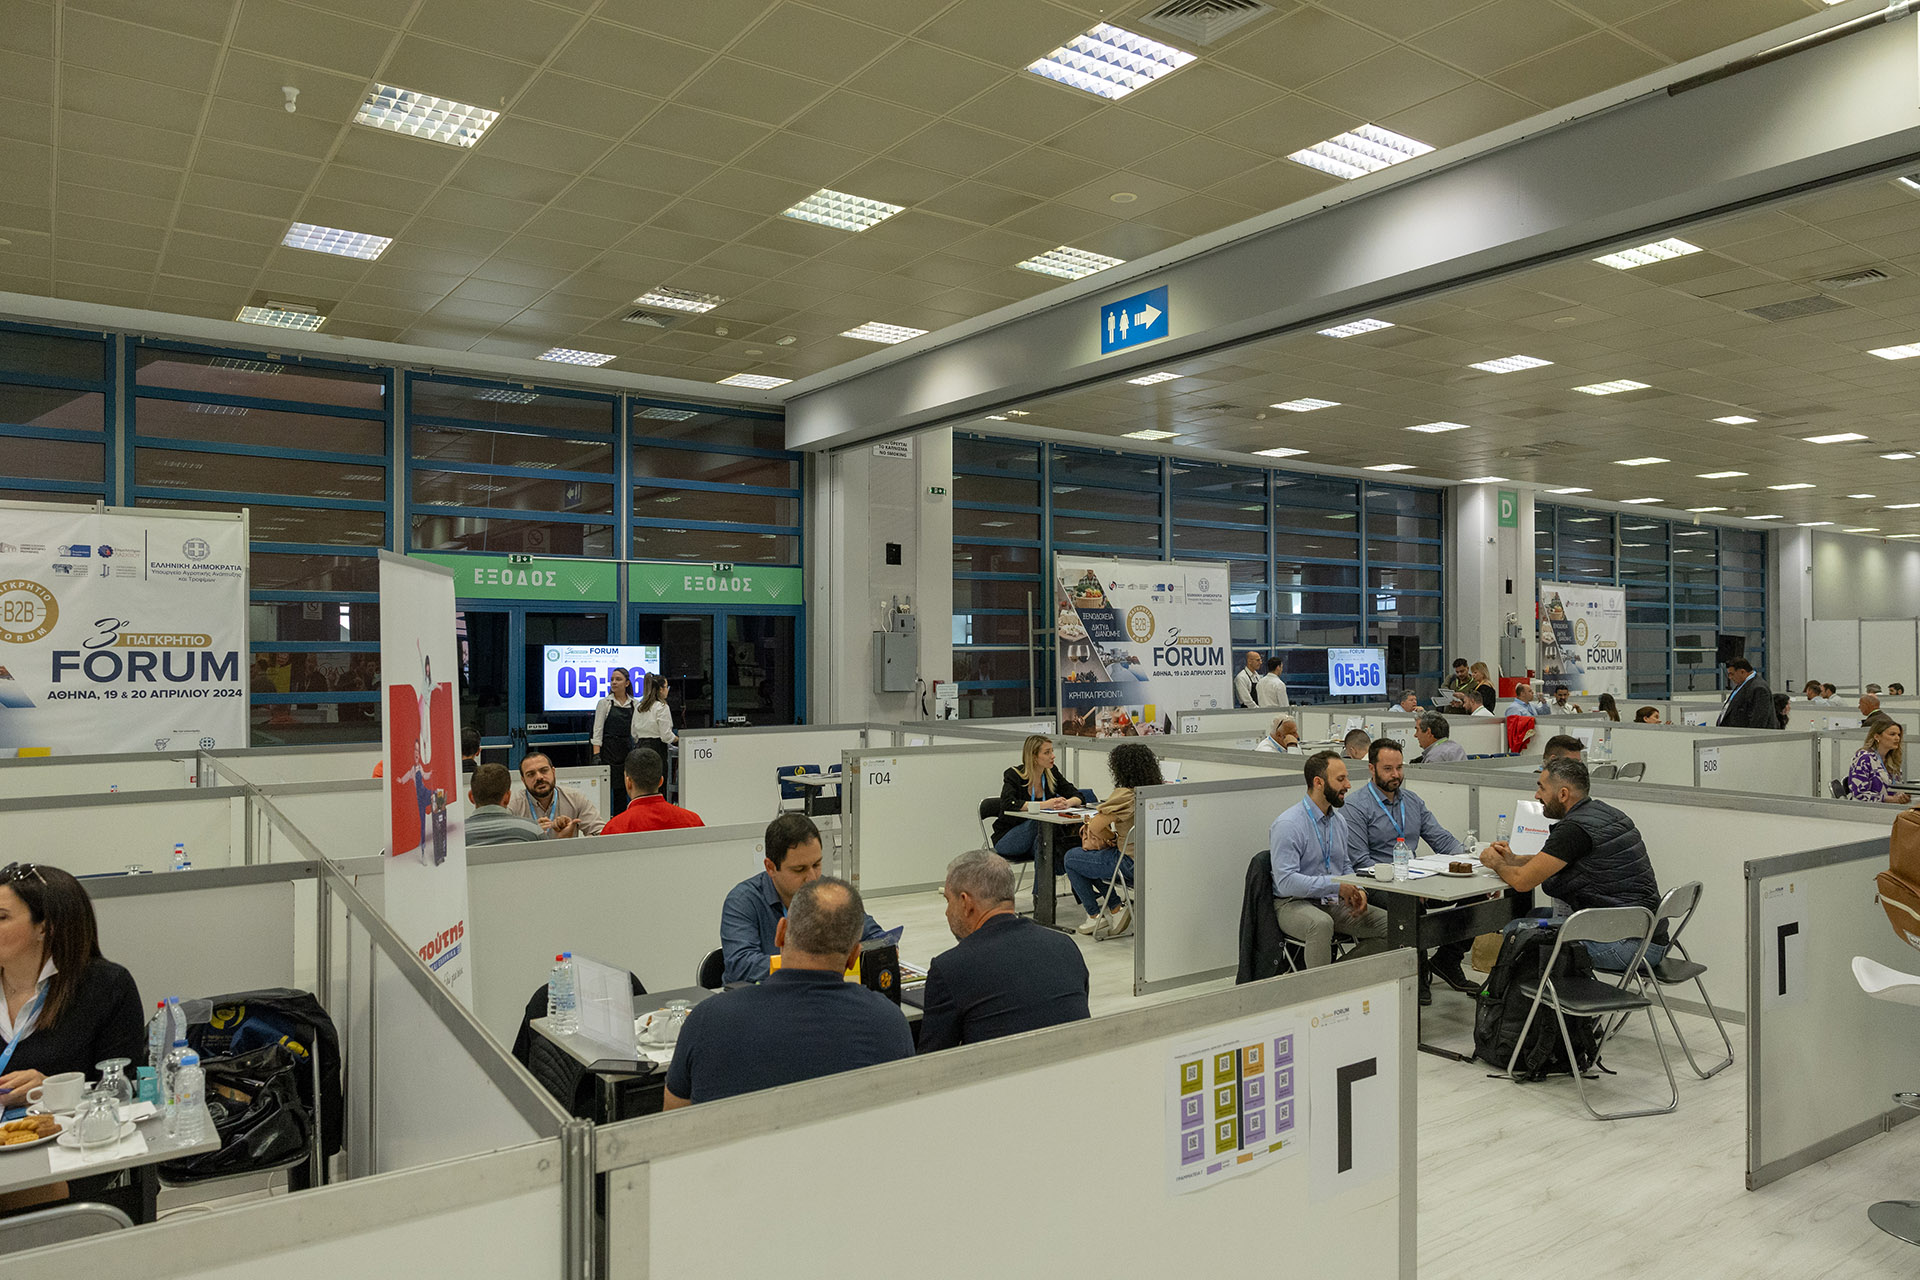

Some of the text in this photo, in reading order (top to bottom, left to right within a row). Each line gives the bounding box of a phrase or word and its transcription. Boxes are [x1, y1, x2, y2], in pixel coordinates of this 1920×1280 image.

[1502, 499, 1512, 518] D
[192, 563, 242, 571] ΔΗΜΟΚΡΑΤΙΑ
[474, 568, 556, 587] ΕΞΟΔΟΣ
[684, 576, 752, 592] ΕΞΟΔΟΣ
[0, 582, 51, 600] ΓΚΡΗΤΙΟ
[4, 601, 34, 622] B2B
[0, 628, 47, 642] ORUM
[126, 635, 205, 646] ΠΑΓΚΡΗΤΙΟ
[1153, 646, 1224, 667] FORUM
[1587, 648, 1622, 663] FORUM
[52, 650, 239, 682] FORUM
[1334, 663, 1380, 687] 05:56
[47, 690, 101, 701] ΑΘΗΝΑ,
[104, 690, 118, 698] 19
[131, 690, 147, 698] 20
[150, 689, 209, 698] ΑΠΡΙΛΙΟΥ
[213, 688, 242, 697] 2024
[1069, 691, 1093, 699] ΚΡΗΤΙΚΑ
[419, 920, 464, 962] σούτης
[1777, 921, 1799, 996] Γ
[1337, 1056, 1377, 1175] Γ
